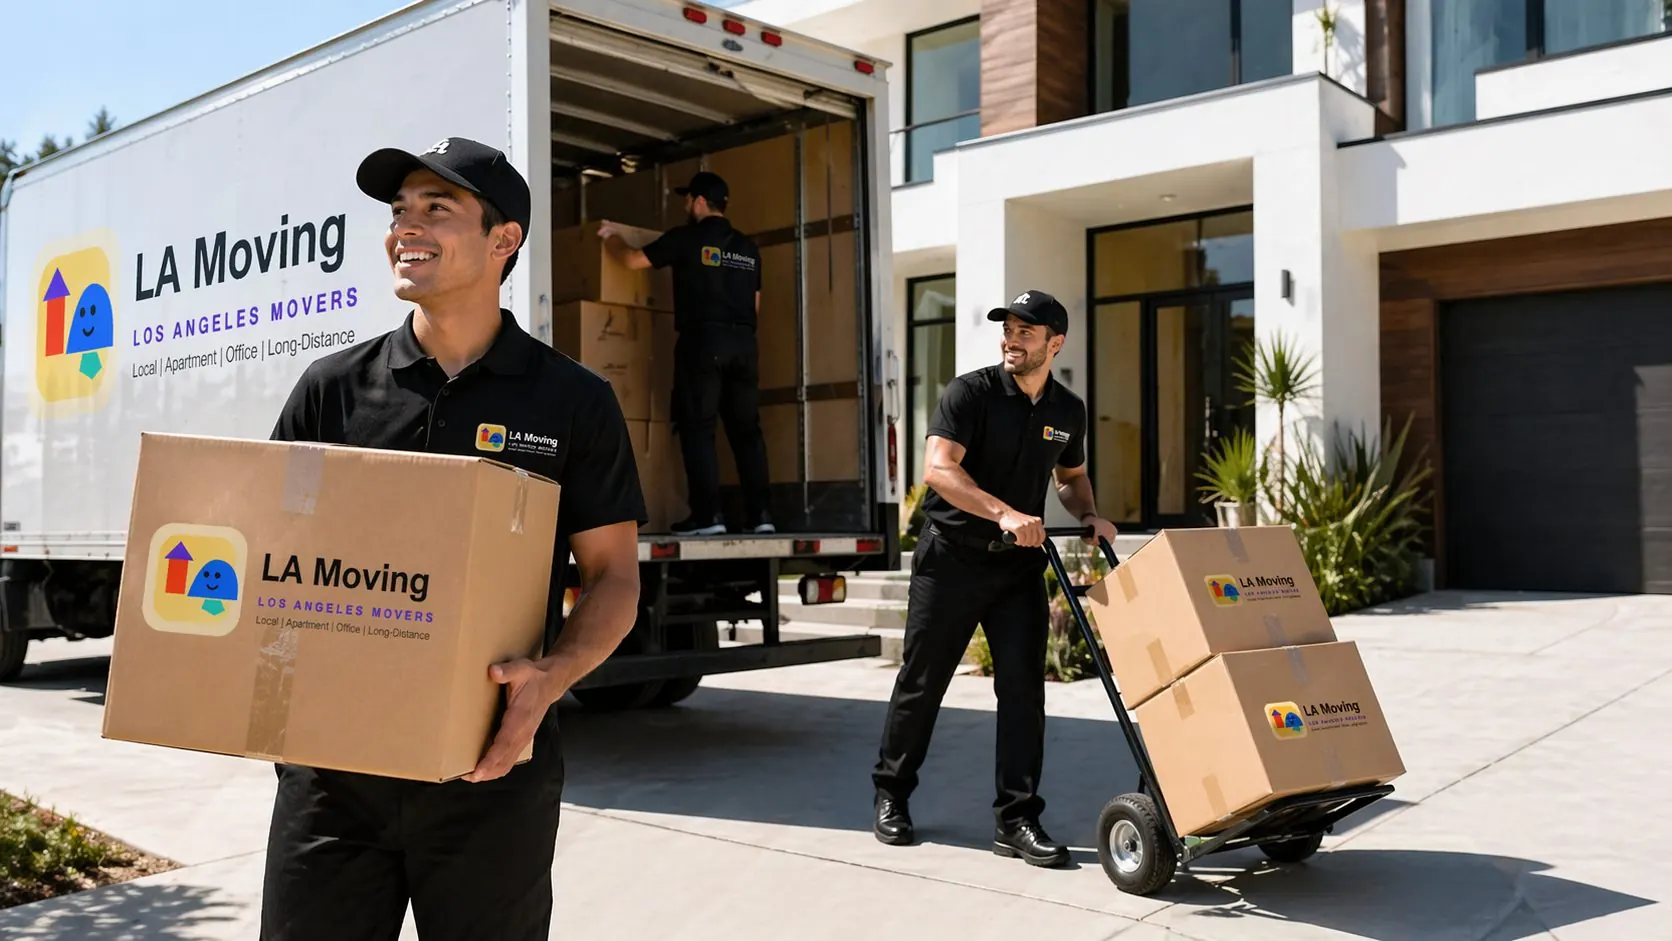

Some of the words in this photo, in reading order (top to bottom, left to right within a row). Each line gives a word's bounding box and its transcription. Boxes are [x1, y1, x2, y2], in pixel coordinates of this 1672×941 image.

[136, 245, 181, 301] LA
[194, 213, 346, 289] Moving
[133, 324, 164, 346] LOS
[173, 306, 259, 340] ANGELES
[271, 287, 358, 321] MOVERS
[132, 359, 157, 378] Local
[165, 351, 217, 375] Apartment
[226, 344, 258, 363] Office
[268, 329, 355, 357] Long-Distance
[509, 431, 521, 440] LA
[524, 432, 558, 448] Moving
[262, 553, 303, 584] LA
[313, 557, 430, 603] Moving
[1240, 577, 1255, 588] LA
[1255, 576, 1295, 588] Moving
[257, 597, 286, 609] LOS
[293, 600, 364, 616] ANGELES
[372, 607, 434, 623] MOVERS
[256, 616, 279, 626] Local
[285, 618, 329, 632] Apartment
[336, 622, 361, 634] Office
[368, 626, 430, 641] Long-Distance
[1303, 705, 1319, 717] LA
[1320, 701, 1360, 715] Moving
